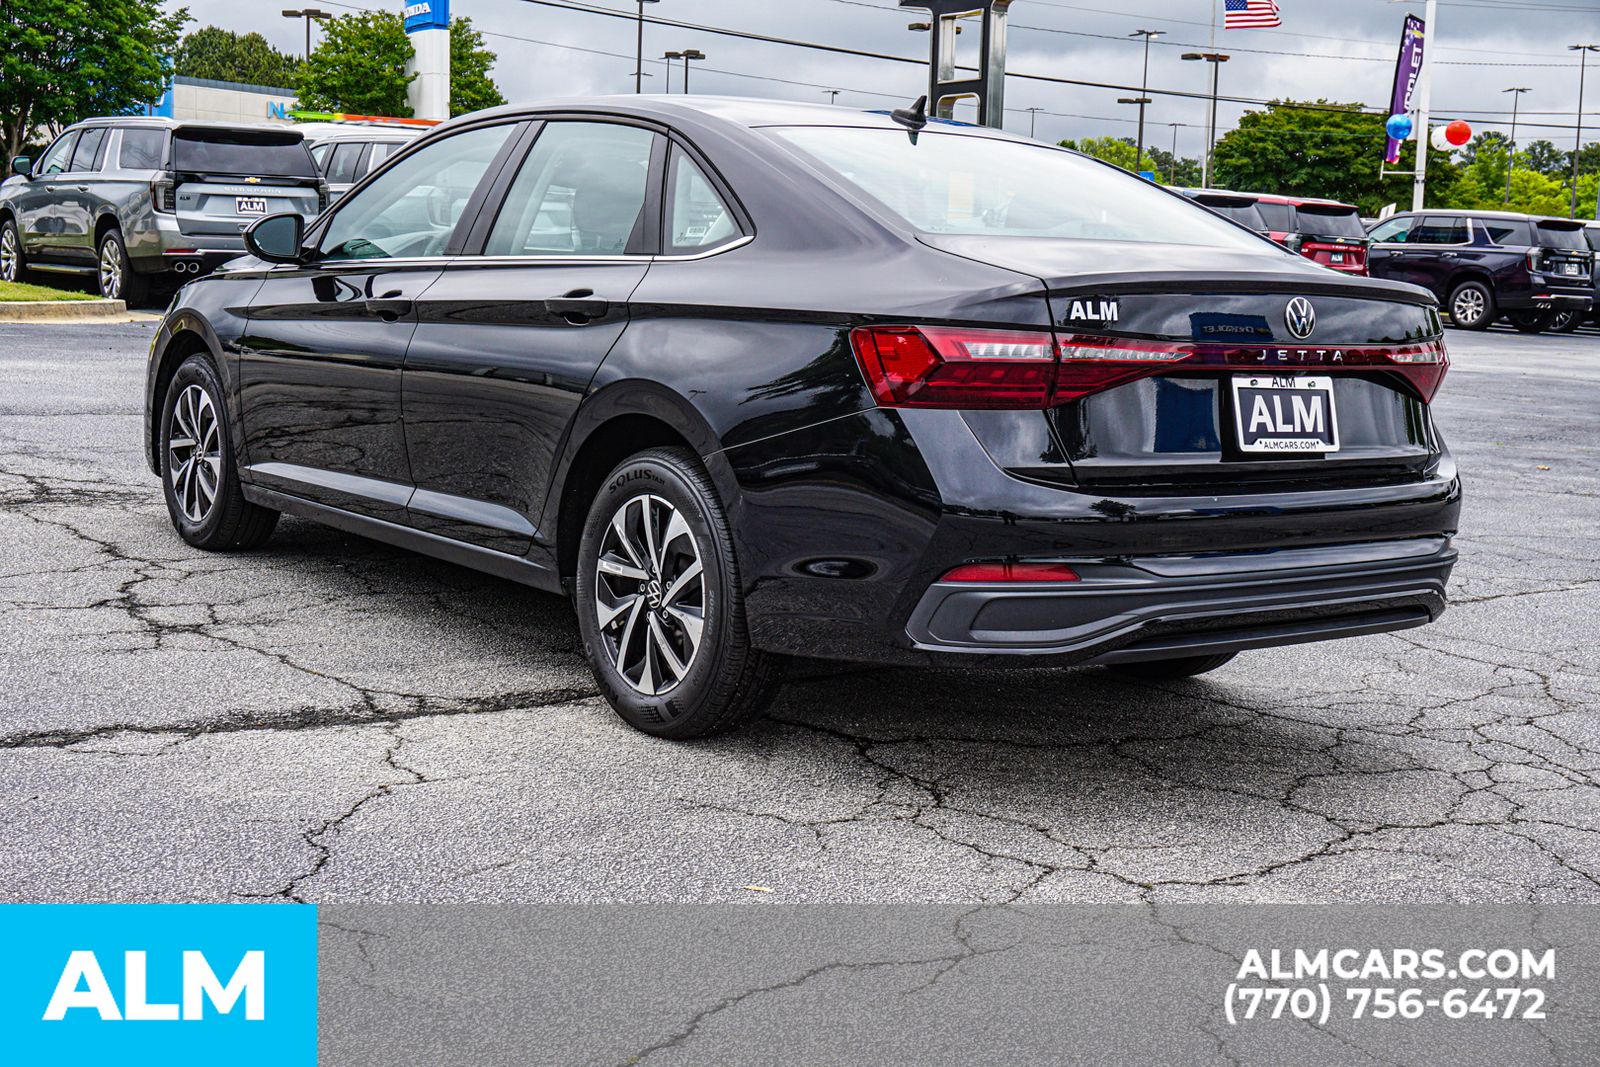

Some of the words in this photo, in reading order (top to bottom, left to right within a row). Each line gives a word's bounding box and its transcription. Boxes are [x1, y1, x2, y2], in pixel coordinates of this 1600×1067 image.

[240, 202, 264, 211] ALM
[1070, 300, 1119, 321] ALM
[1257, 349, 1343, 361] JETTA
[1271, 376, 1296, 388] ALM
[1249, 394, 1324, 433] ALM
[1263, 440, 1317, 450] ALMCARS.COM
[609, 469, 652, 494] SOLUS
